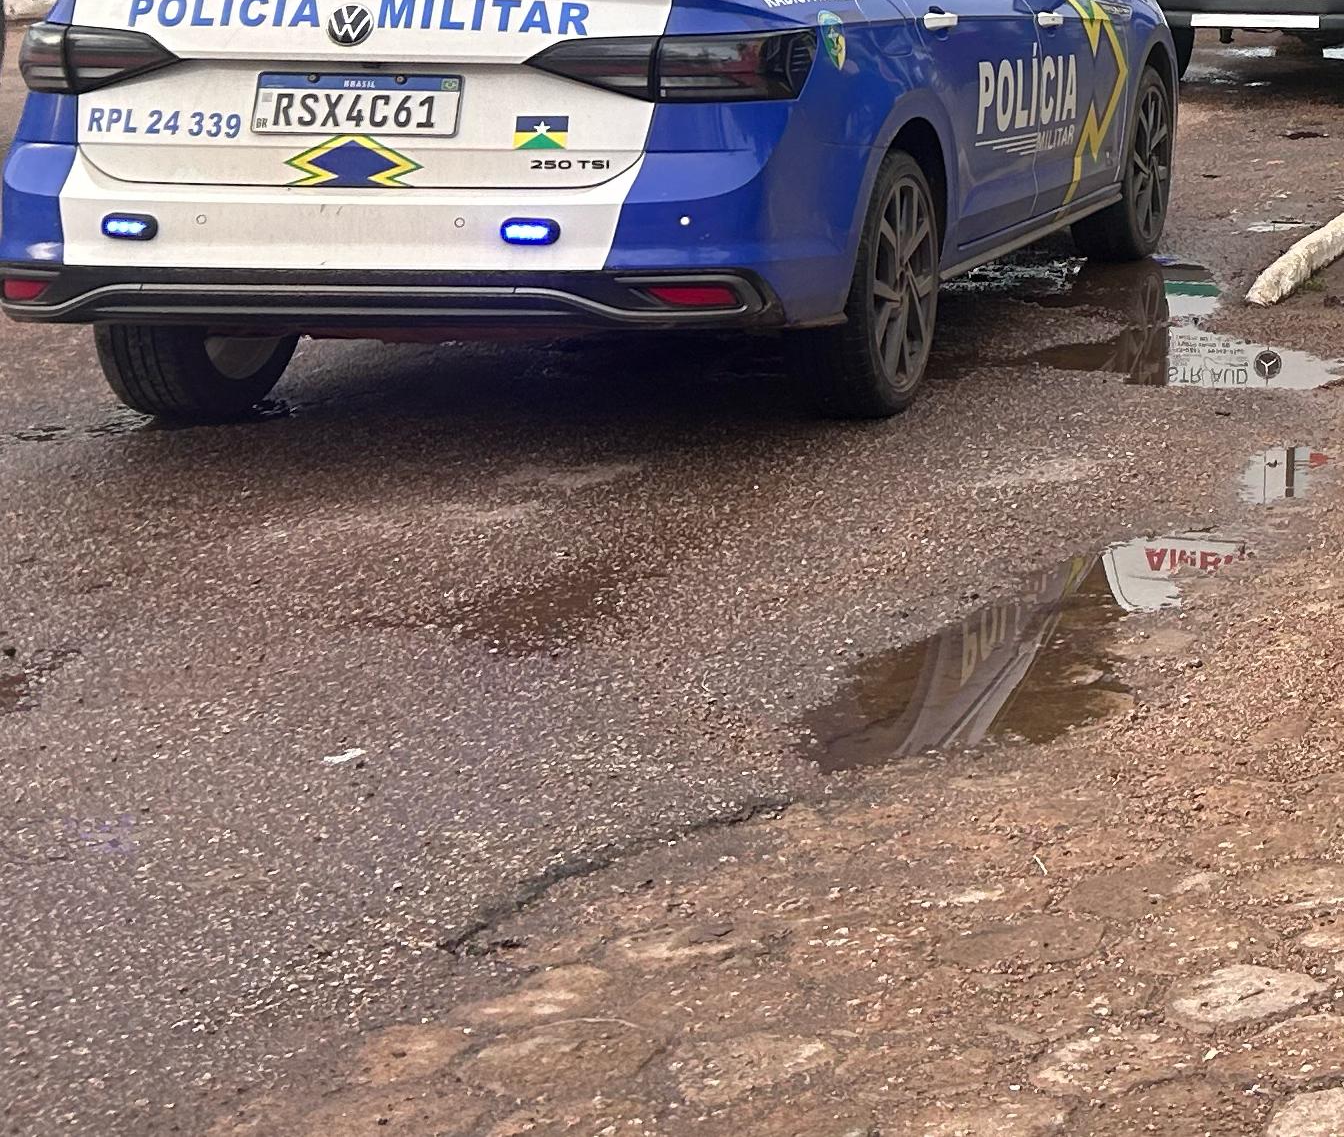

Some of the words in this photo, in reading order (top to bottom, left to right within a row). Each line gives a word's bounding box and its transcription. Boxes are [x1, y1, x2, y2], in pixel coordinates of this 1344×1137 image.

[976, 42, 1077, 135] POLÍCIA
[87, 108, 137, 133] RPL
[145, 110, 181, 135] 24
[188, 111, 241, 139] 339
[272, 93, 436, 128] RSX4C61
[1036, 124, 1076, 151] MILITAR
[530, 159, 572, 170] 250
[577, 160, 610, 170] TSI
